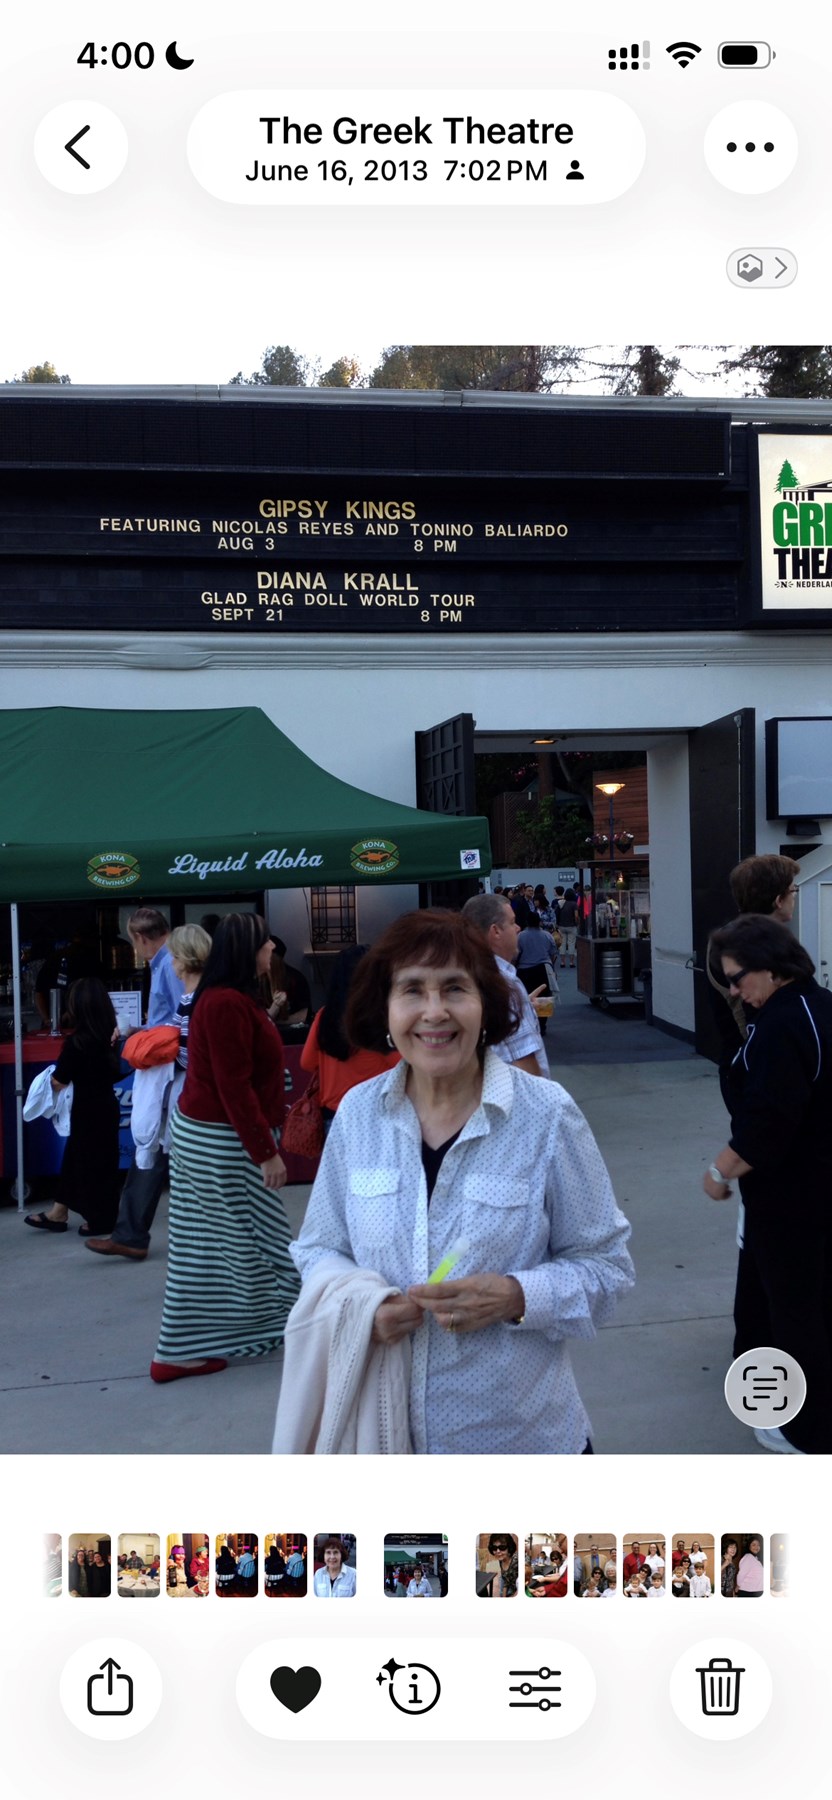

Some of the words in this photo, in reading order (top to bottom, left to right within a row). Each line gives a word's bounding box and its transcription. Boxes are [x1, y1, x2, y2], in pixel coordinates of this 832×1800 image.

[259, 499, 328, 519] GIPSY
[346, 501, 416, 520] KINGS
[100, 518, 201, 533] FEATURING
[212, 520, 288, 534] NICOLAS
[299, 522, 354, 535] REYES
[365, 523, 399, 536] AND
[410, 523, 474, 537] TONINO
[485, 525, 568, 538] BALIARDO
[217, 537, 254, 550] AUG
[265, 538, 275, 550] 3
[413, 540, 424, 552] 8
[433, 540, 457, 552] PM
[257, 571, 328, 590] DIANA
[344, 572, 419, 591] KRALL
[200, 592, 248, 605] GLAD
[258, 593, 294, 606] RAG
[304, 594, 348, 606] DOLL
[359, 594, 420, 606] WORLD
[430, 594, 475, 607] TOUR
[211, 608, 254, 621] SEPT
[265, 609, 283, 621] 21
[420, 610, 430, 622] 8
[440, 611, 462, 623] PM
[361, 841, 386, 849] KONA
[100, 854, 125, 862] KONA
[168, 852, 249, 880] Liquid
[255, 848, 323, 870] Aloha
[355, 862, 385, 872] BREWING
[93, 875, 125, 886] BREWING
